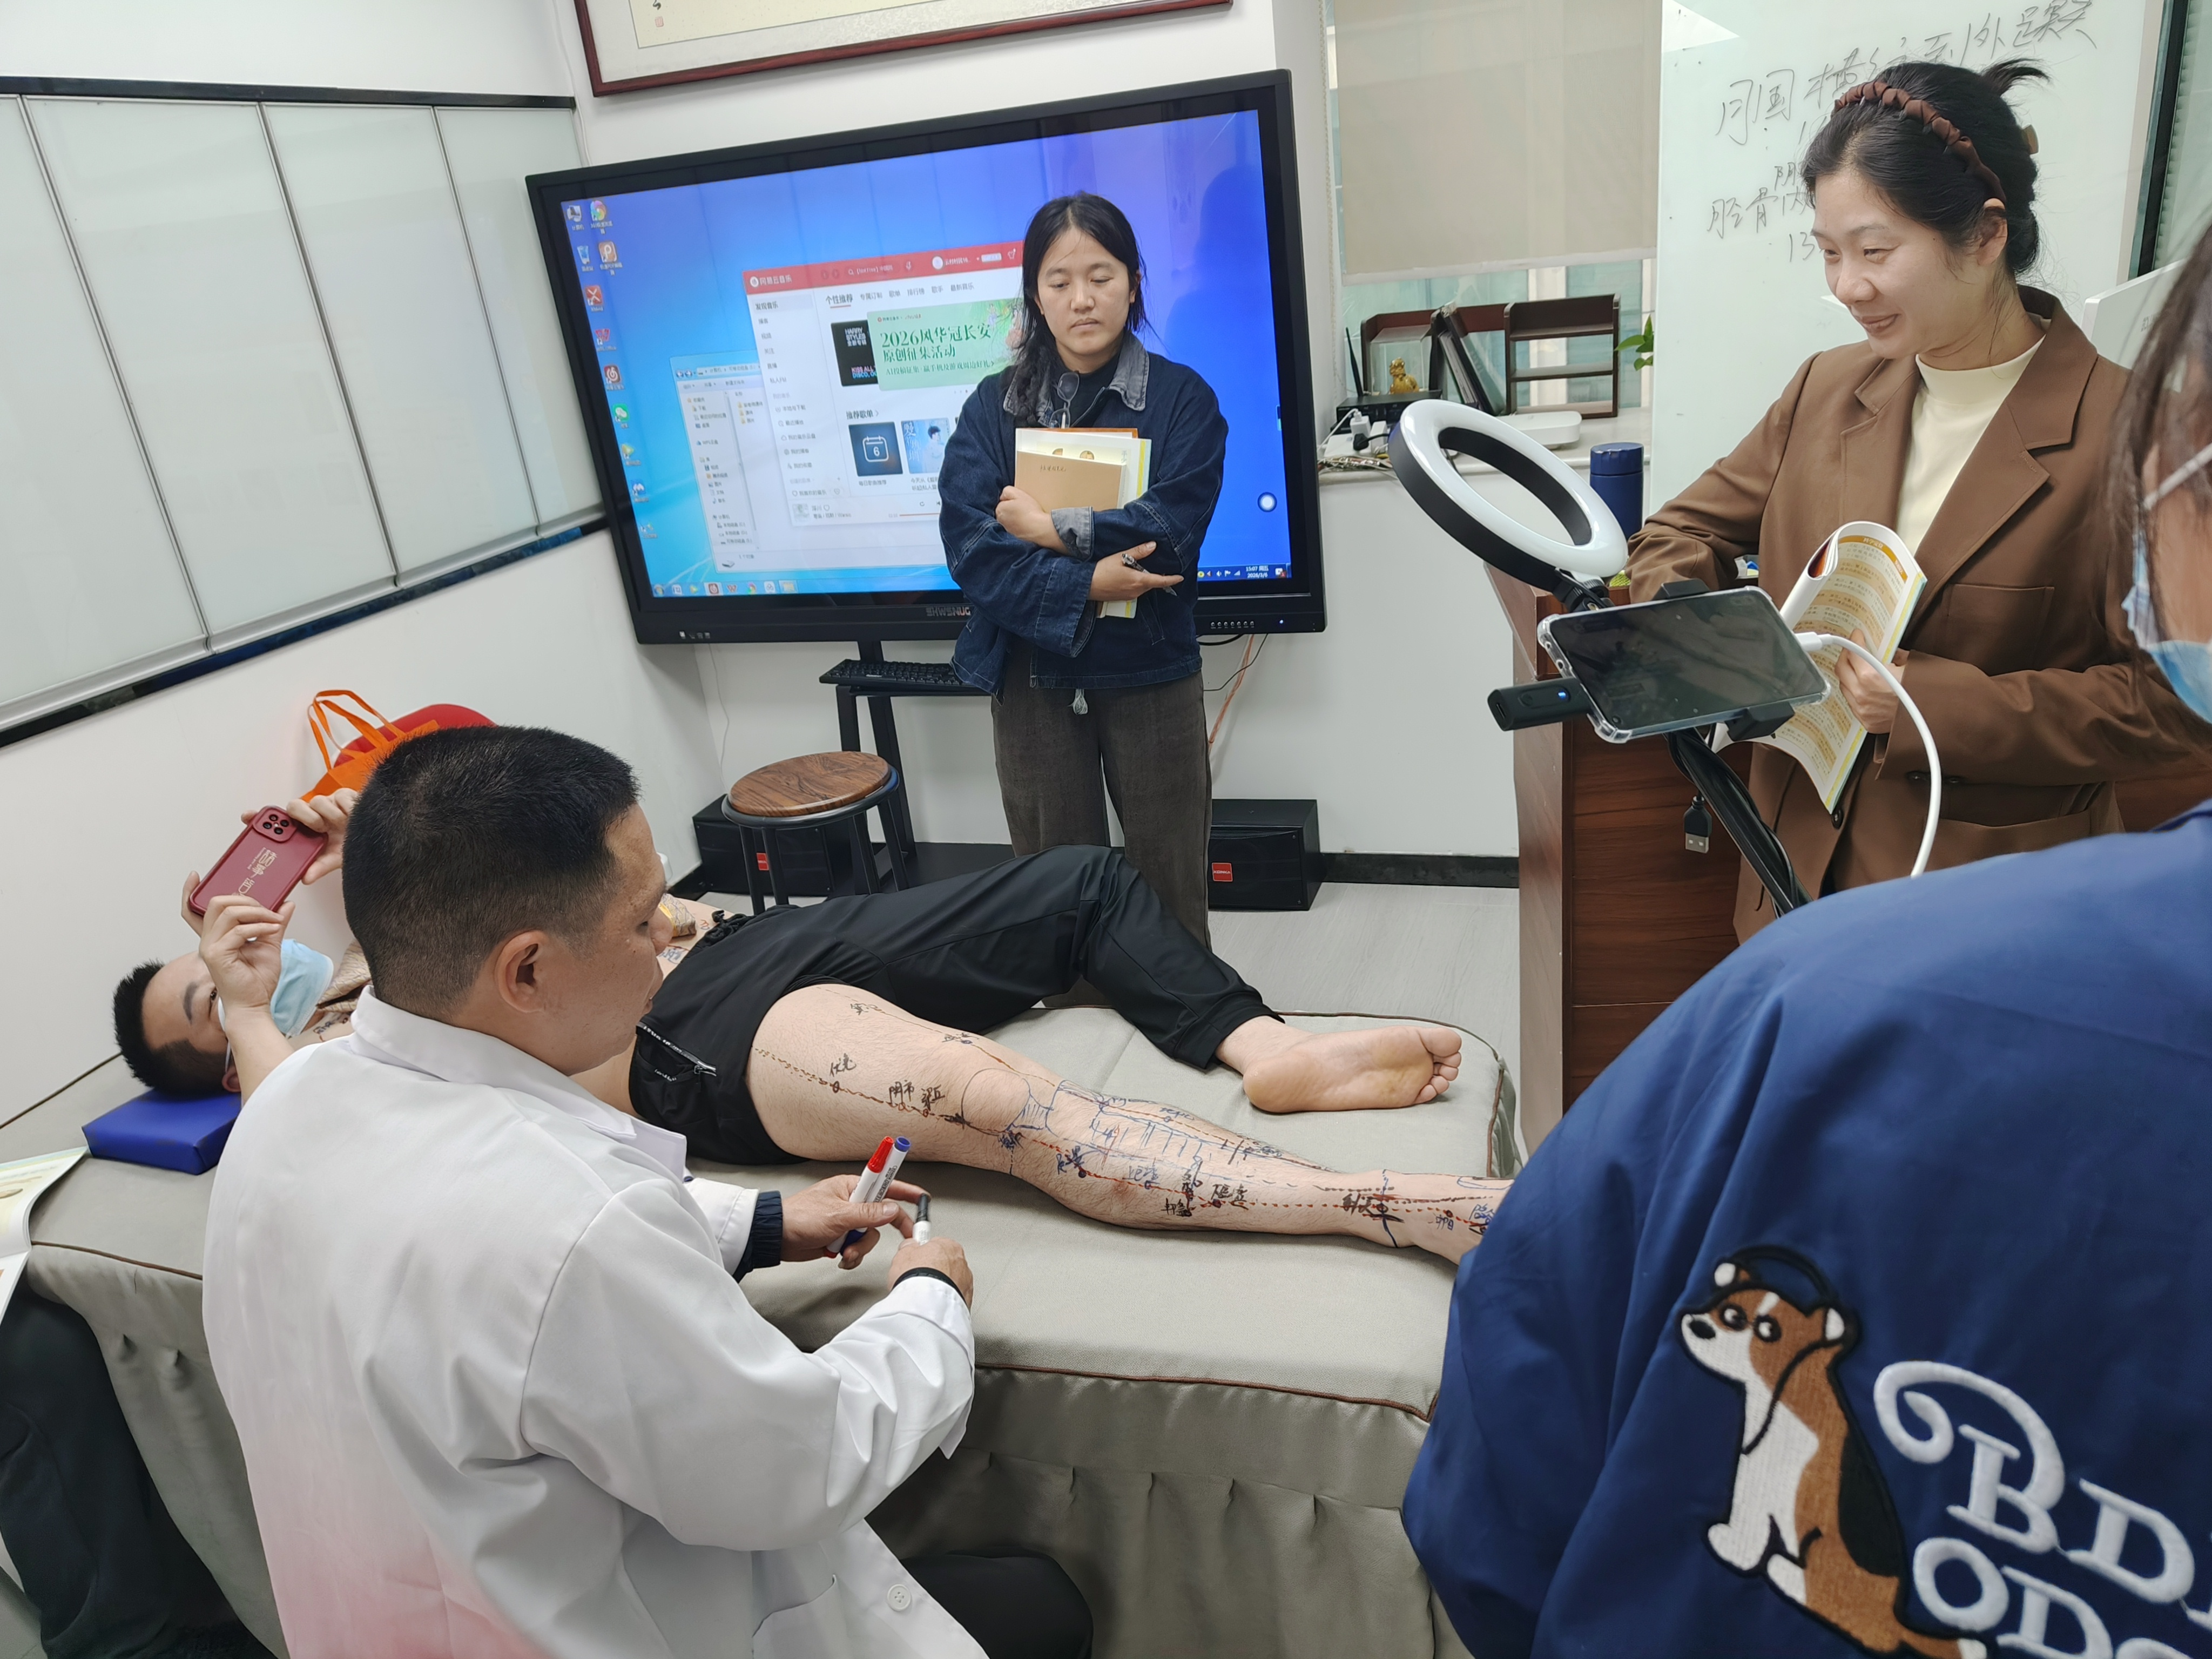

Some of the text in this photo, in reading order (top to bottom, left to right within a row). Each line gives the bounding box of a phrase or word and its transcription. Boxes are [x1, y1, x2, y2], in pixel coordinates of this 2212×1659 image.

[826, 293, 853, 305] 个性推荐
[755, 301, 779, 311] 发现音乐
[845, 326, 863, 334] HARRY
[880, 323, 992, 348] 2026风华冠长安
[846, 333, 866, 341] STYLES
[883, 343, 956, 363] 原创征集活动
[846, 409, 874, 420] 推荐歌单
[873, 446, 880, 457] 6
